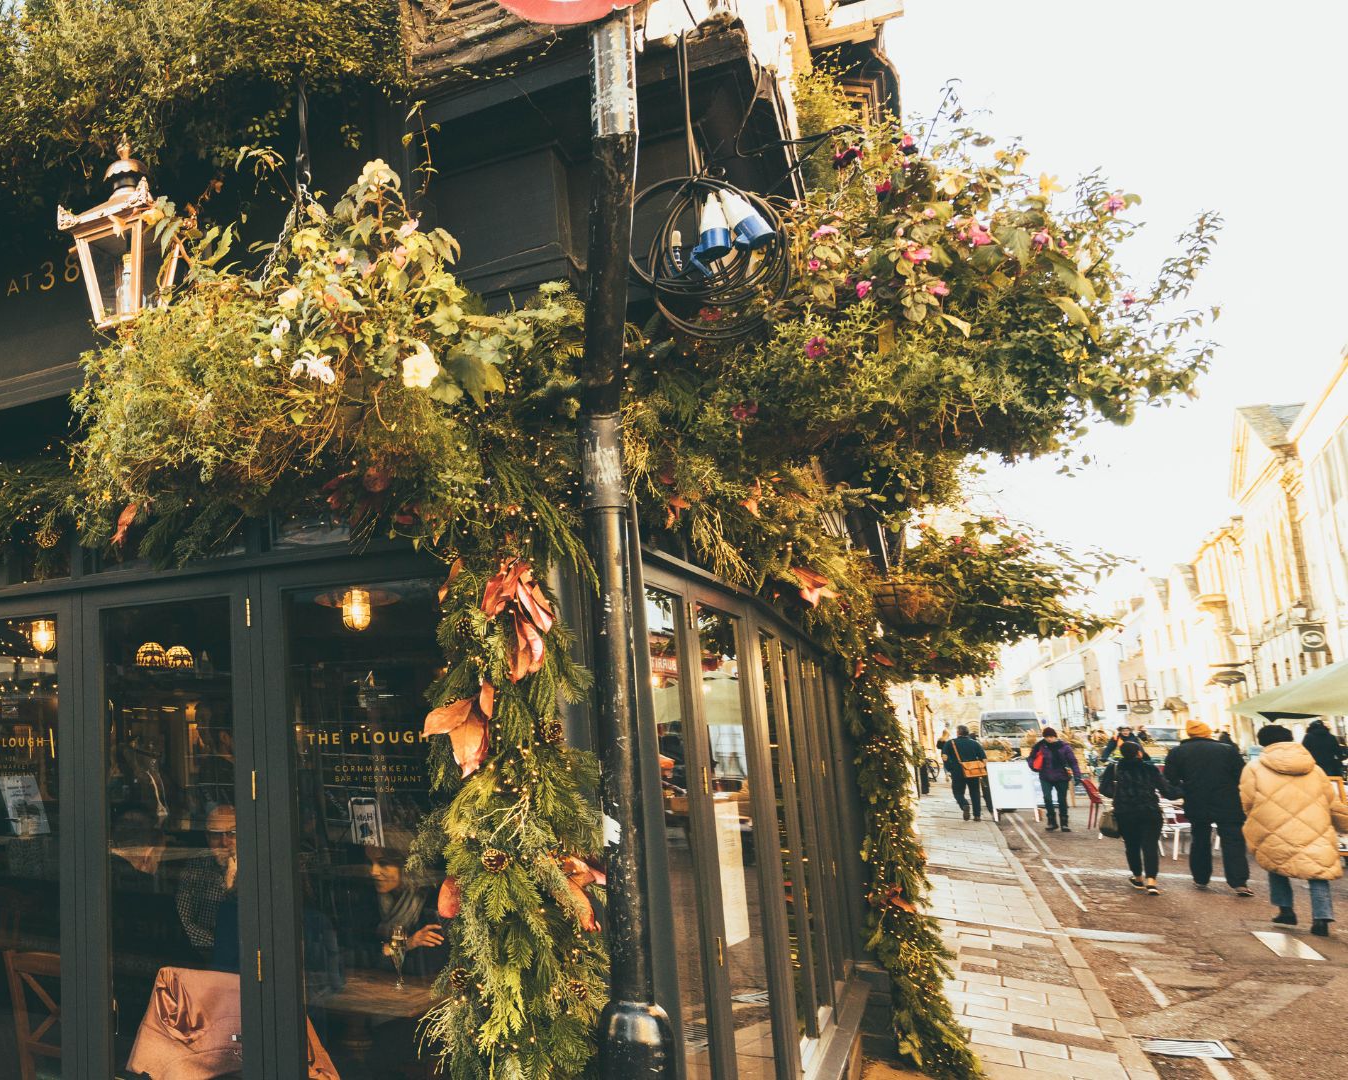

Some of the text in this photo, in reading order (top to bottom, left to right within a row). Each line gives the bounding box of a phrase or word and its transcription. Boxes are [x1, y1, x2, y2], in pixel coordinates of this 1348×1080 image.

[7, 273, 33, 297] AT
[39, 253, 81, 291] 38
[307, 731, 429, 745] THE PLOUGH
[362, 775, 422, 783] RESTAURANT
